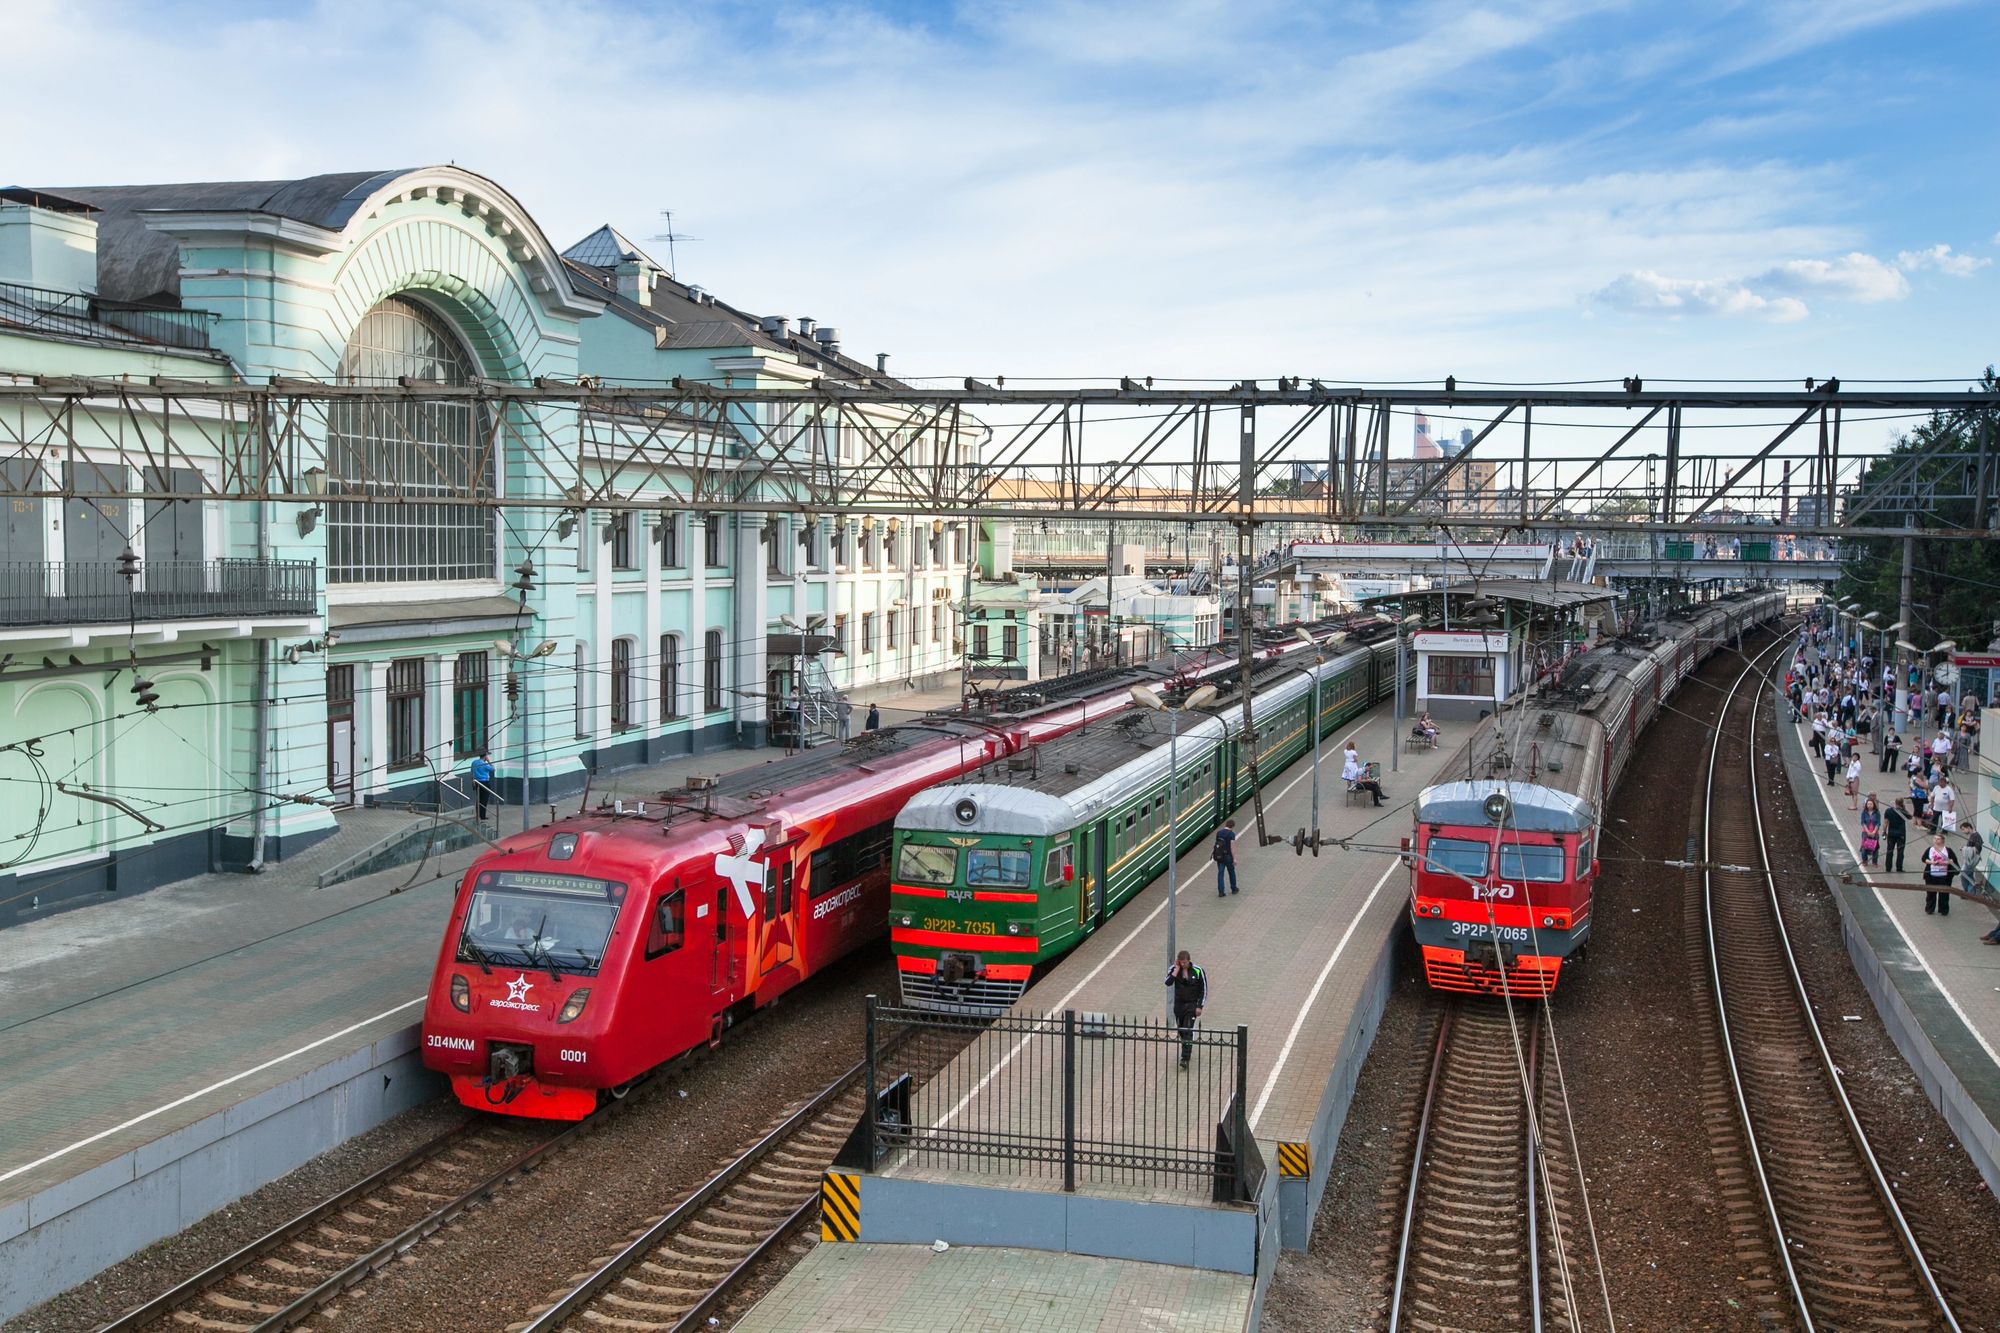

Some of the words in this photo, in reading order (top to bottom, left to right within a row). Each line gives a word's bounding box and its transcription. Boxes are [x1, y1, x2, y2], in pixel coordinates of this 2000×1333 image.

[515, 874, 602, 889] Шереметьево
[813, 883, 862, 919] аэроэкспресс
[946, 889, 973, 904] RVR
[489, 999, 541, 1011] аэроэкспресс
[427, 1034, 475, 1051] ЭД4МКМ
[560, 1049, 587, 1063] 0001
